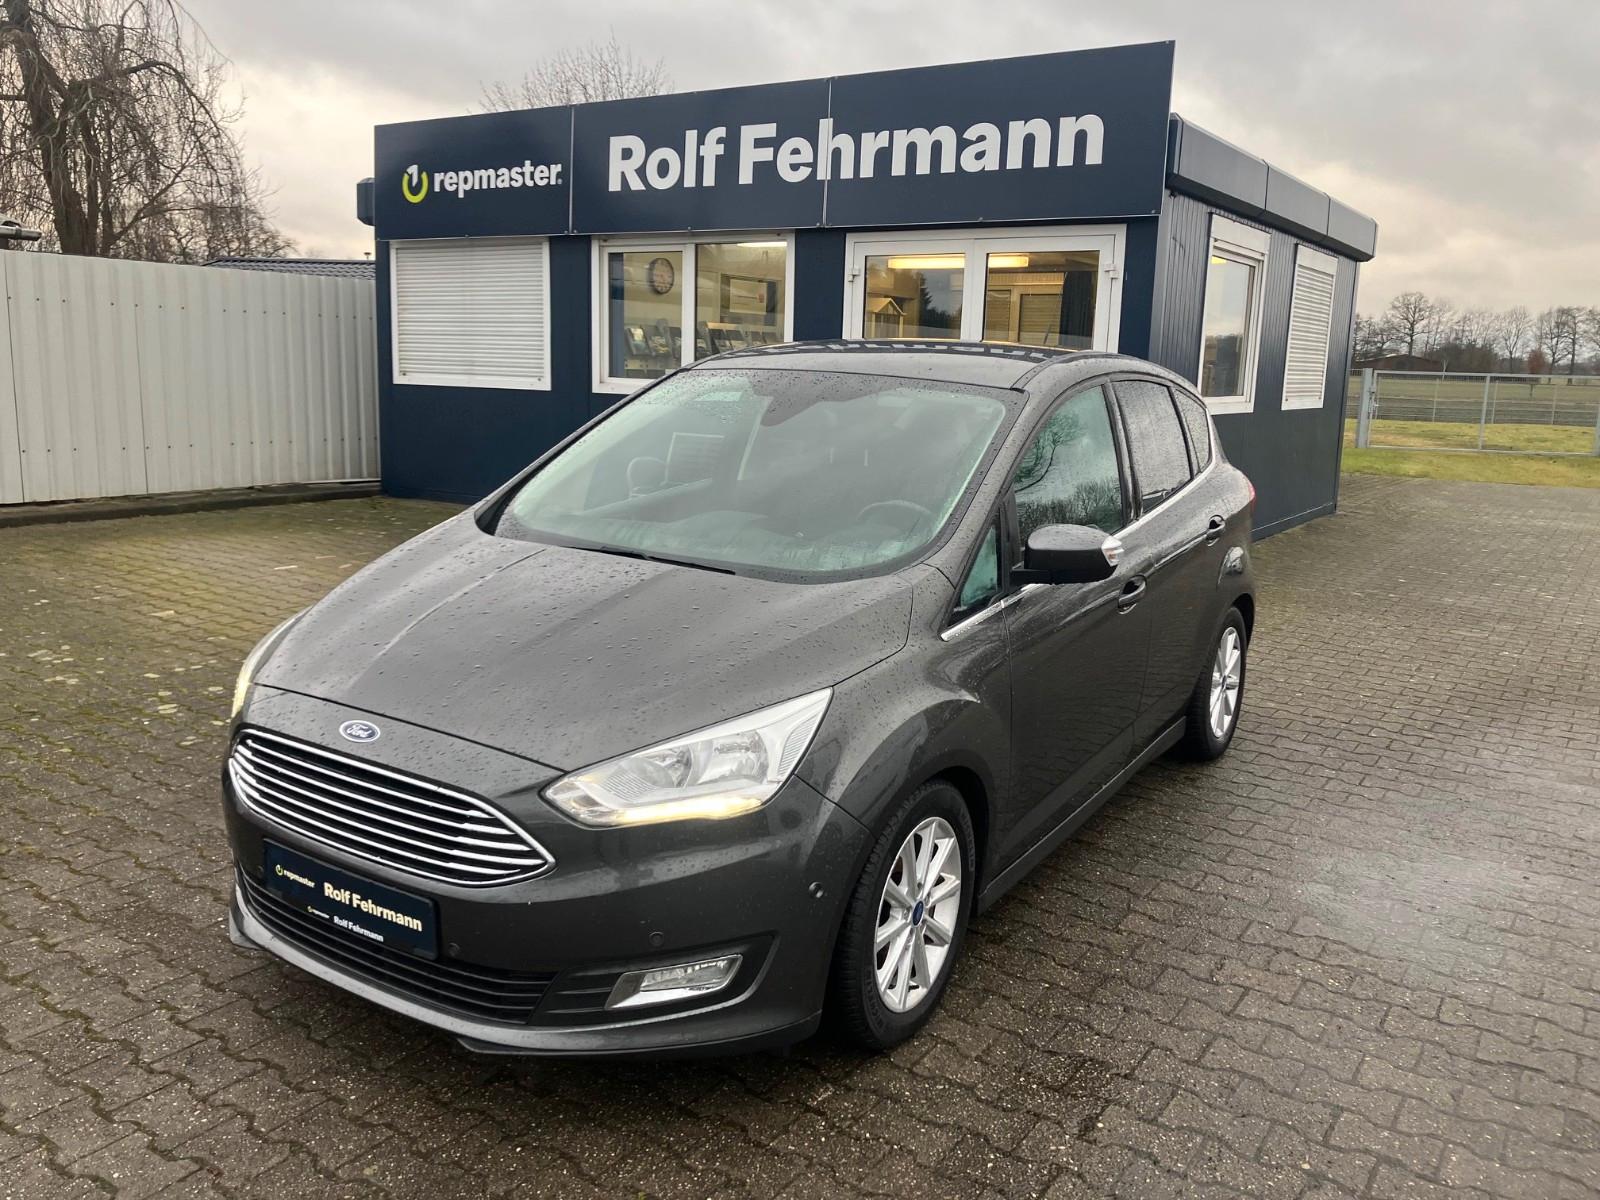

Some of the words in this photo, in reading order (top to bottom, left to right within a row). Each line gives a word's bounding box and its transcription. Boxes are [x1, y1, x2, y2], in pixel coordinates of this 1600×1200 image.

[608, 126, 726, 192] Rolf
[738, 113, 1105, 185] Fehrmann
[323, 881, 351, 904] Rolf
[352, 892, 422, 932] Fehrmann
[333, 915, 348, 929] Rolf
[348, 921, 384, 943] Fehrmann
